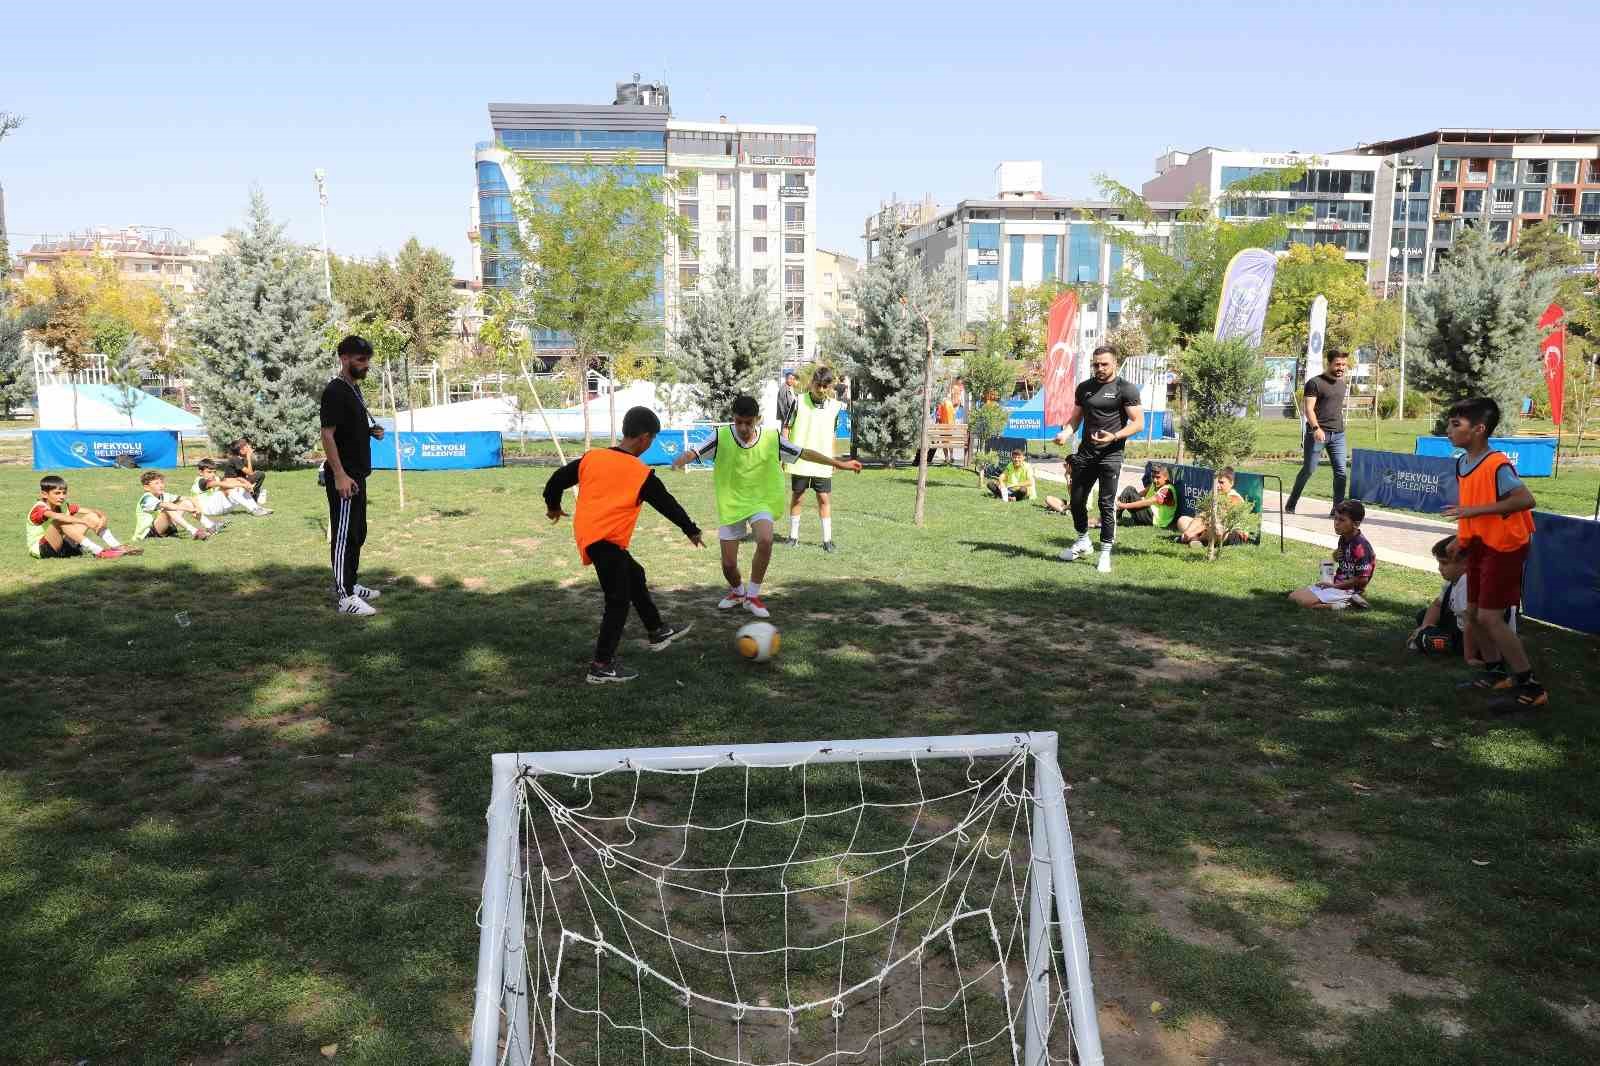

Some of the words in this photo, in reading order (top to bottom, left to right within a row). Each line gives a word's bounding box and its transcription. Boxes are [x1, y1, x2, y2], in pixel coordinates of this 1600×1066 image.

[93, 440, 142, 450] İPEKYOLU
[1397, 470, 1439, 484] İPEKYOLU
[1396, 480, 1438, 494] BELEDİYESİ
